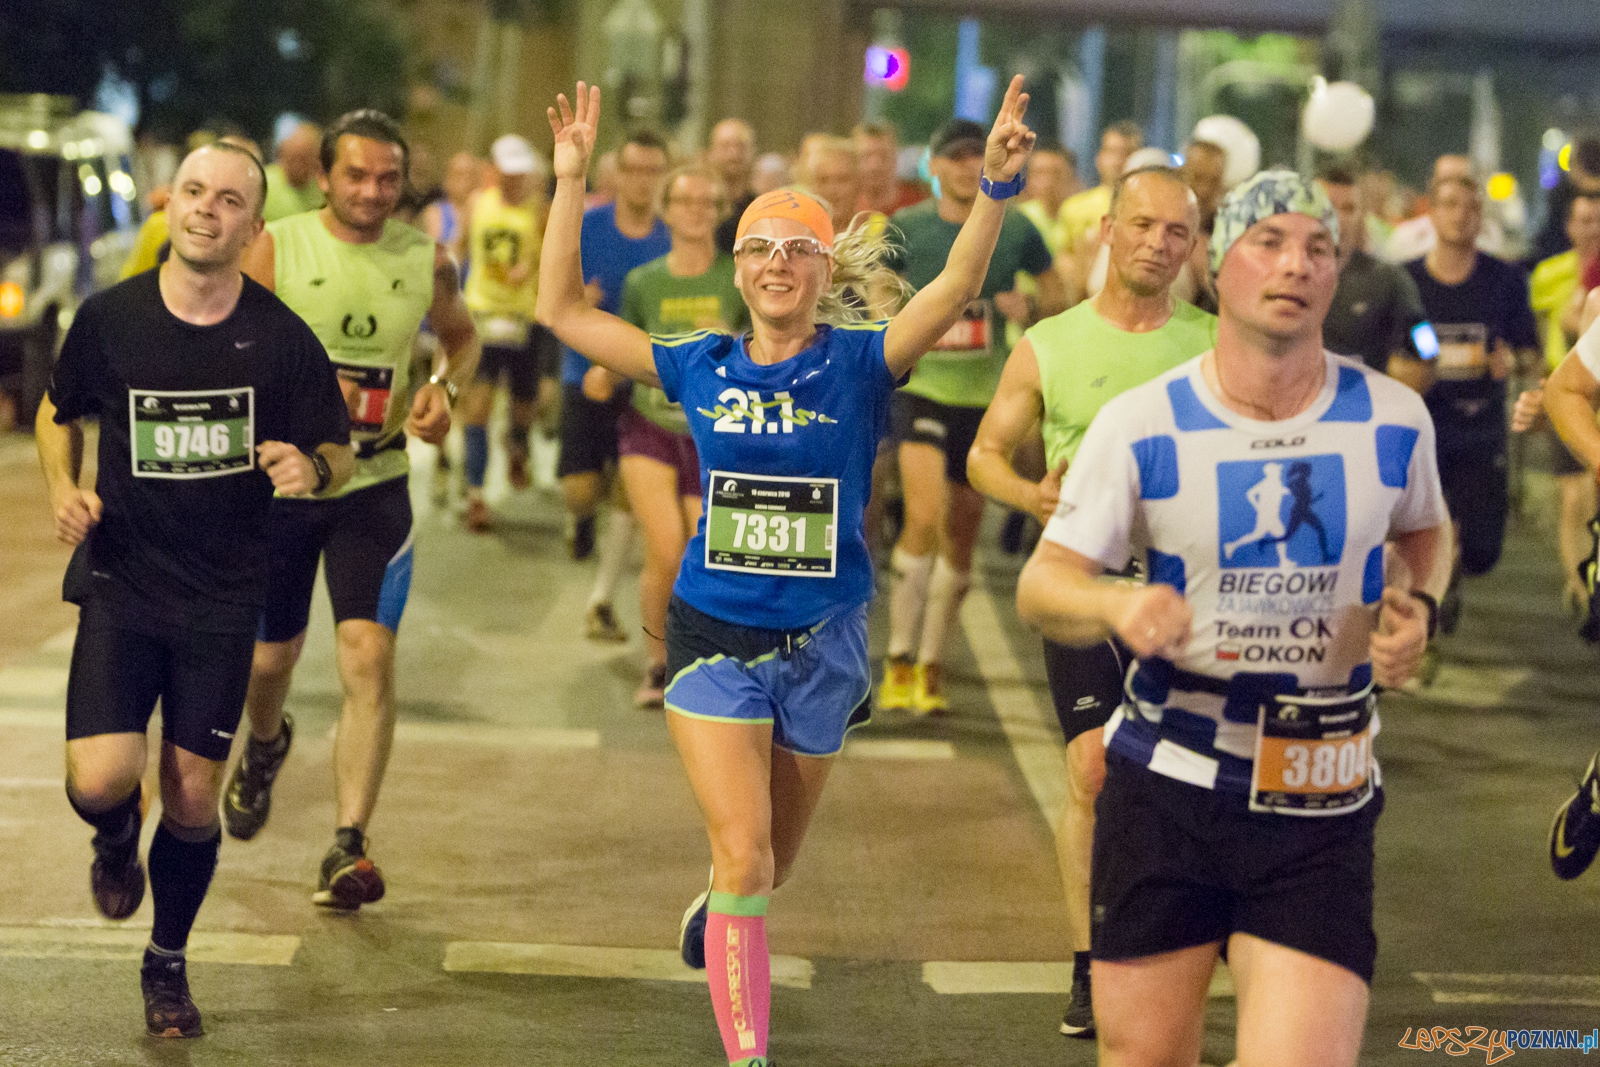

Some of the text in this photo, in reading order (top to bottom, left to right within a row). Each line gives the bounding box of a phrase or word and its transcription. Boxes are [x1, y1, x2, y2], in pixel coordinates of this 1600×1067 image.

[714, 387, 793, 434] 21.1
[154, 423, 230, 458] 9746
[731, 512, 807, 553] 7331
[1219, 571, 1339, 594] BIEGOWI
[1215, 616, 1334, 639] Team OK
